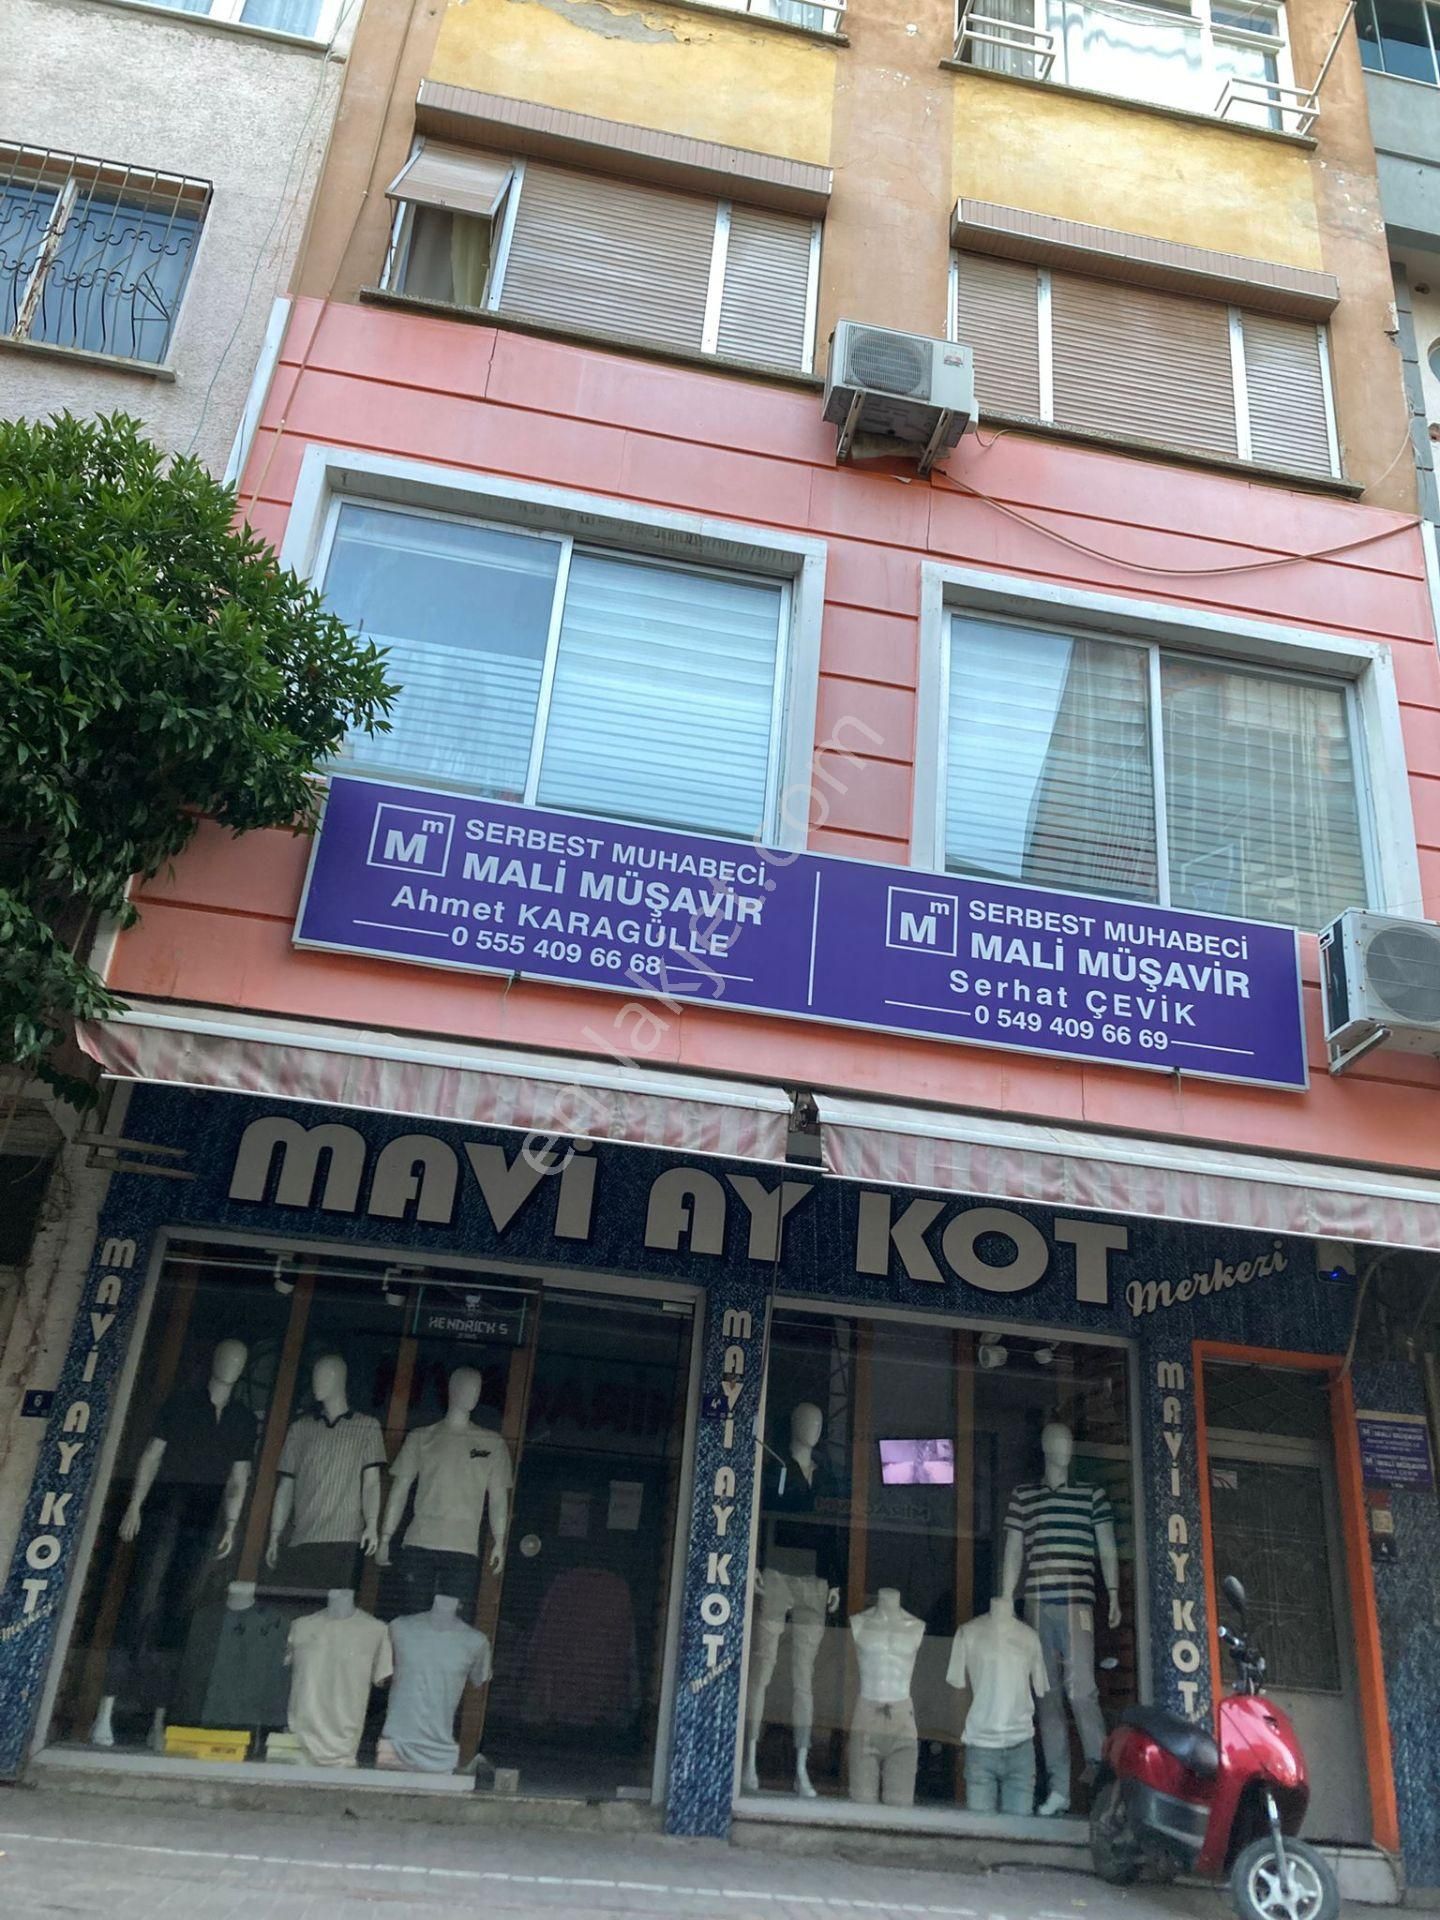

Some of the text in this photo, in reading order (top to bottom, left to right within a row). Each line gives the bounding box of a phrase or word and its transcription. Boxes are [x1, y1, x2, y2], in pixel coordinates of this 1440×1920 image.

[461, 851, 763, 926] MALİ MÜŞAVİR
[464, 818, 766, 887] SERBEST MUHABECİ
[390, 885, 730, 959] Ahmet KARAGÜLLE
[451, 926, 662, 976] 0 555 409 66 68
[968, 899, 1249, 960] SERBEST MUHABECİ
[949, 969, 1197, 1027] Serhat ÇEVİK
[970, 931, 1251, 999] MALİ MÜŞAVİR
[974, 1005, 1169, 1051] 0 549 409 66 69
[643, 1166, 815, 1263] AY
[854, 1190, 1129, 1305] KOT
[1125, 1240, 1289, 1318] Merkezi
[21, 1491, 71, 1614] KOT
[700, 1552, 734, 1668] KOT
[1171, 1598, 1201, 1715] KOT
